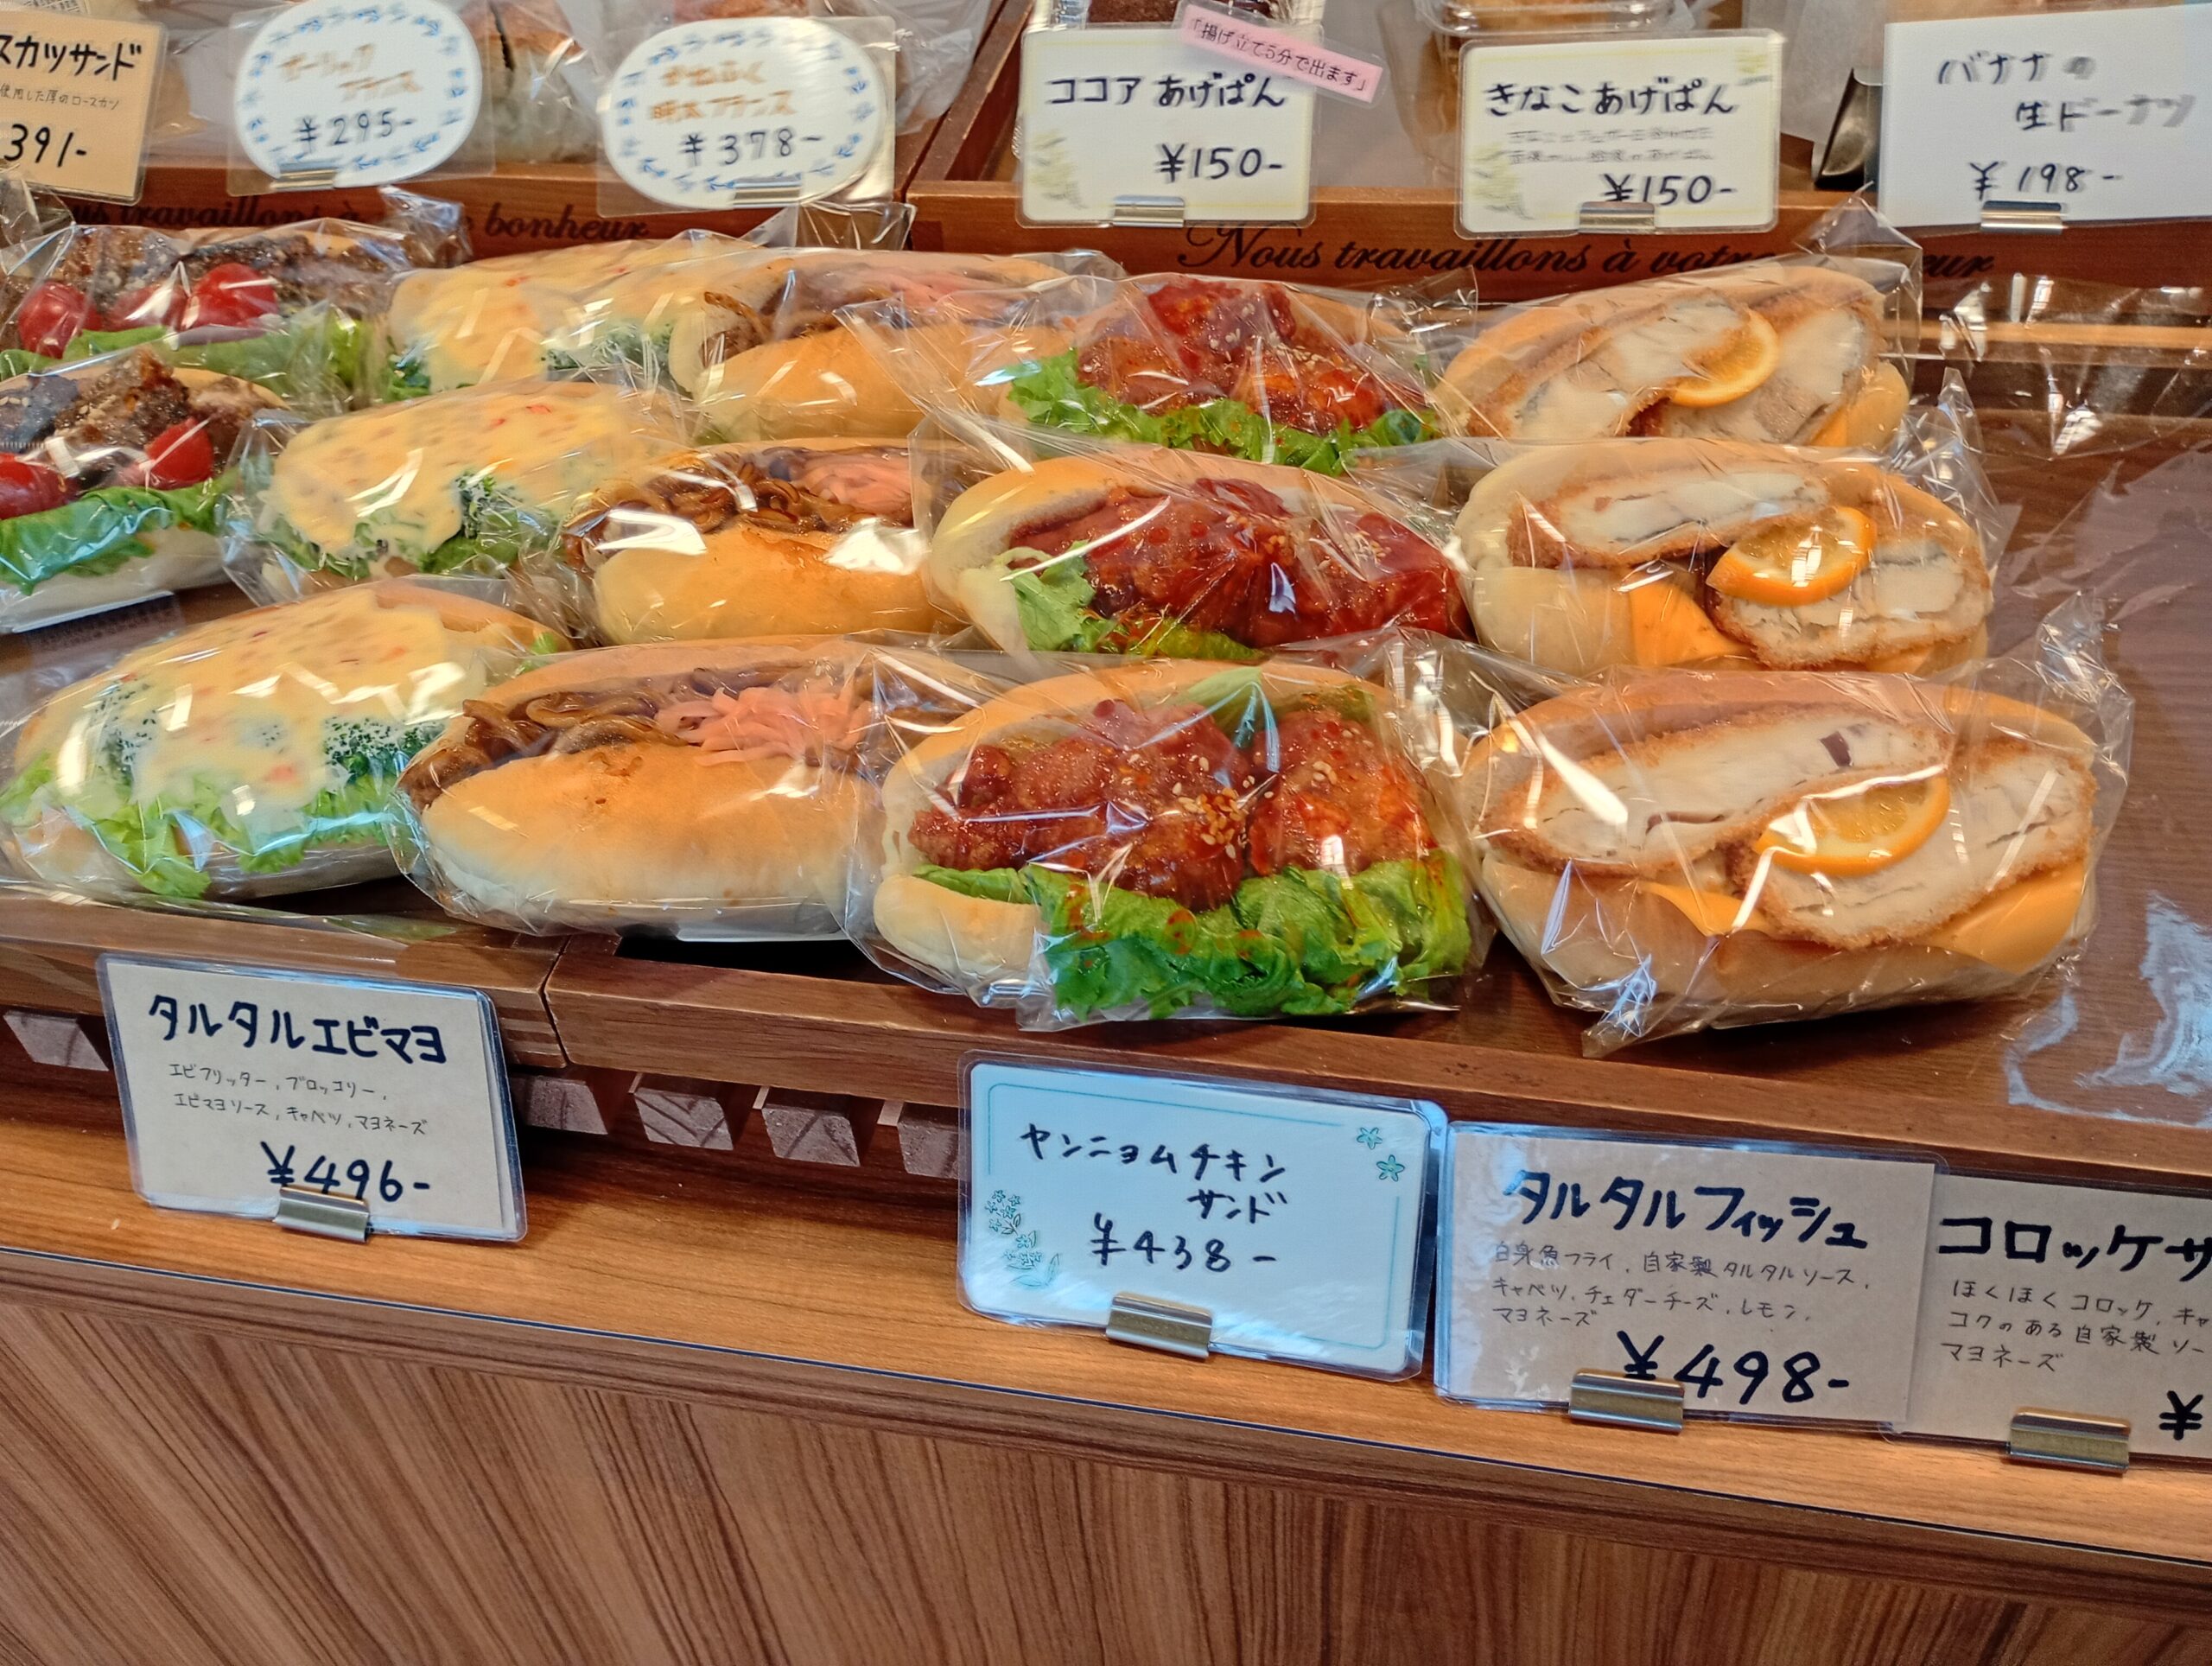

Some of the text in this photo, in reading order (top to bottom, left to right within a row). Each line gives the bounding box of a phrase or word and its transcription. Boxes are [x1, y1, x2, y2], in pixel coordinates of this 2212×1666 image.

[0, 35, 142, 81] スカツサンド
[1486, 77, 1736, 118] きなこあげぱん
[486, 202, 650, 240] bonheur
[1177, 225, 1324, 269] Nous
[1335, 238, 1591, 272] travaillons
[1603, 237, 1640, 273] à
[149, 994, 447, 1064] タルタルエビマヨ
[1189, 1189, 1287, 1224] サンド
[1503, 1169, 1868, 1250] タルタルフィッシュ
[1937, 1217, 2212, 1282] コロッケサ
[1492, 1305, 1598, 1327] マヨネーズ
[1941, 1343, 2064, 1372] マヨネーズ
